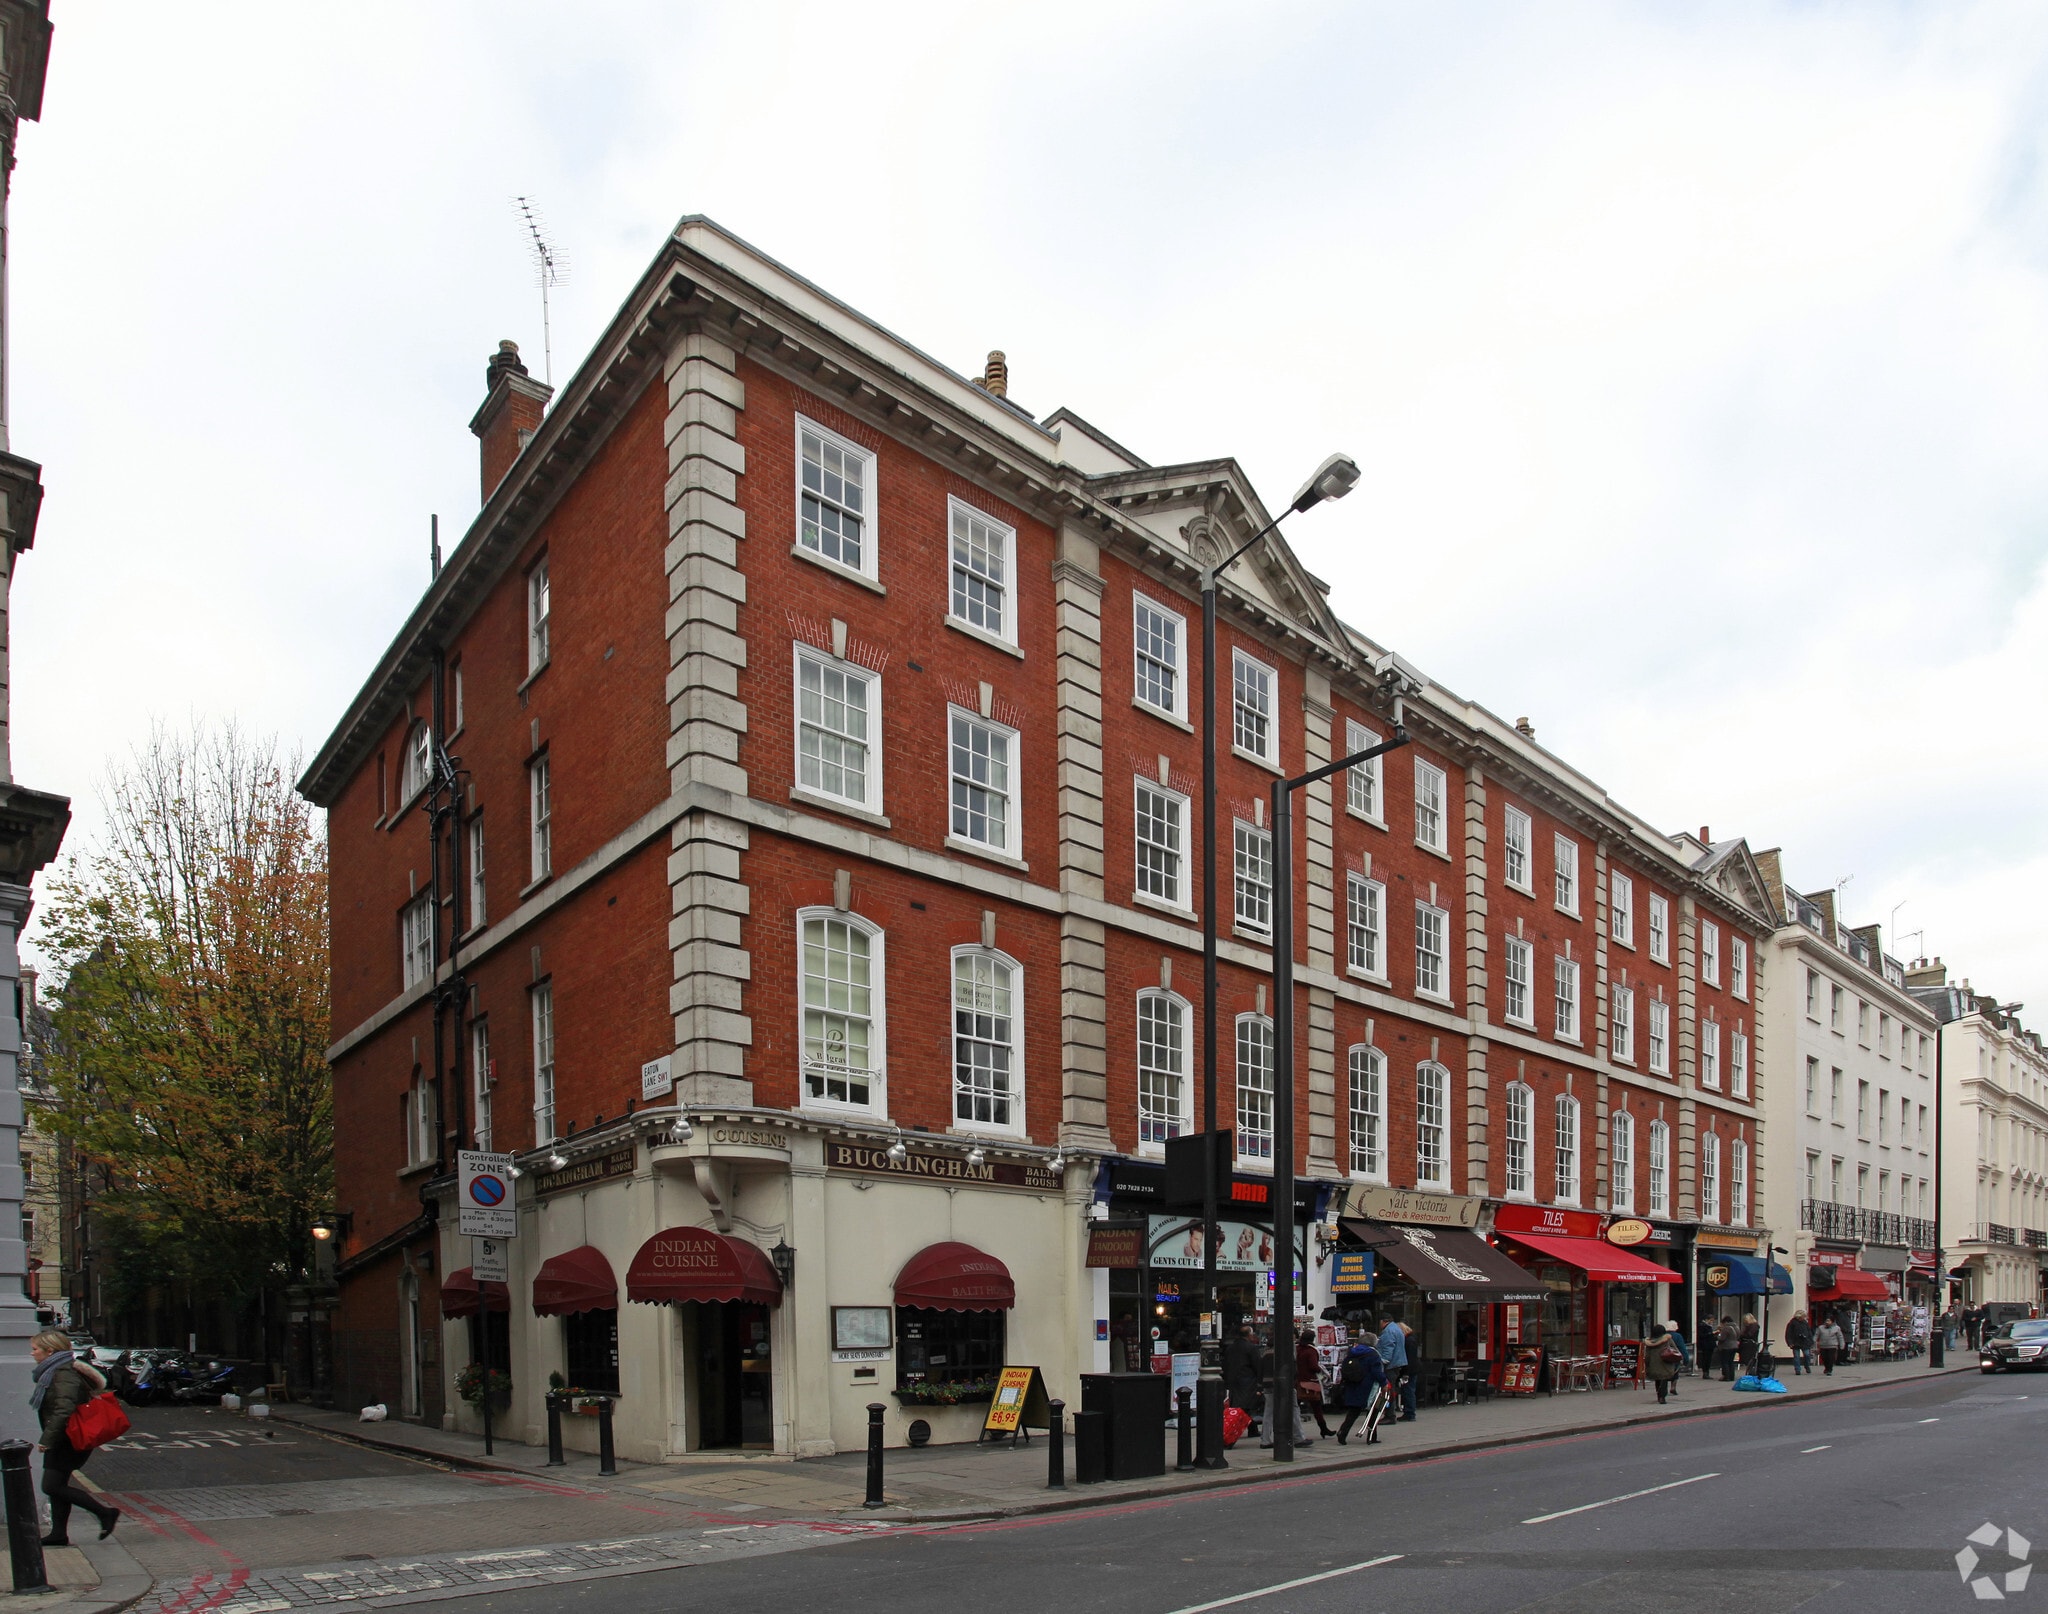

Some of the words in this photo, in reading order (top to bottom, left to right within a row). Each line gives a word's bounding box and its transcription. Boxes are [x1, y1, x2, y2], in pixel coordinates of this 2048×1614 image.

[645, 1064, 659, 1077] EATON
[645, 1075, 656, 1088] LANE
[658, 1072, 668, 1083] SW1
[714, 1129, 787, 1148] CUISINE
[470, 1162, 504, 1173] ZONE
[1025, 1177, 1059, 1188] HOUSE
[1231, 1182, 1268, 1203] HAIR
[1390, 1191, 1409, 1209] Vale
[1414, 1193, 1448, 1212] Victoria
[1378, 1208, 1399, 1219] Cafe
[1410, 1211, 1451, 1223] Restaurant
[1543, 1210, 1565, 1227] TILES
[1616, 1224, 1640, 1232] TILES
[1094, 1229, 1136, 1239] INDIAN
[655, 1240, 717, 1254] INDIAN
[1094, 1241, 1134, 1252] TANDOORI
[482, 1257, 499, 1265] Traffic
[653, 1255, 718, 1268] CUISINE
[1088, 1255, 1136, 1266] RESTAURANT
[1341, 1256, 1363, 1264] PHONES
[474, 1266, 506, 1274] enforcement
[960, 1262, 999, 1273] INDIAN
[1340, 1265, 1363, 1273] REPAIRS
[1708, 1272, 1727, 1284] ups
[952, 1286, 984, 1297] BALTI
[1158, 1283, 1179, 1295] NAILS
[1331, 1283, 1370, 1292] ACCESSORIES
[1156, 1294, 1180, 1302] BEAUTY
[838, 1351, 850, 1360] MORE
[850, 1351, 860, 1359] SEATS
[861, 1350, 885, 1359] DOWNSTAIRS
[1001, 1380, 1026, 1388] CUISINE
[991, 1411, 1018, 1424] £6.95
